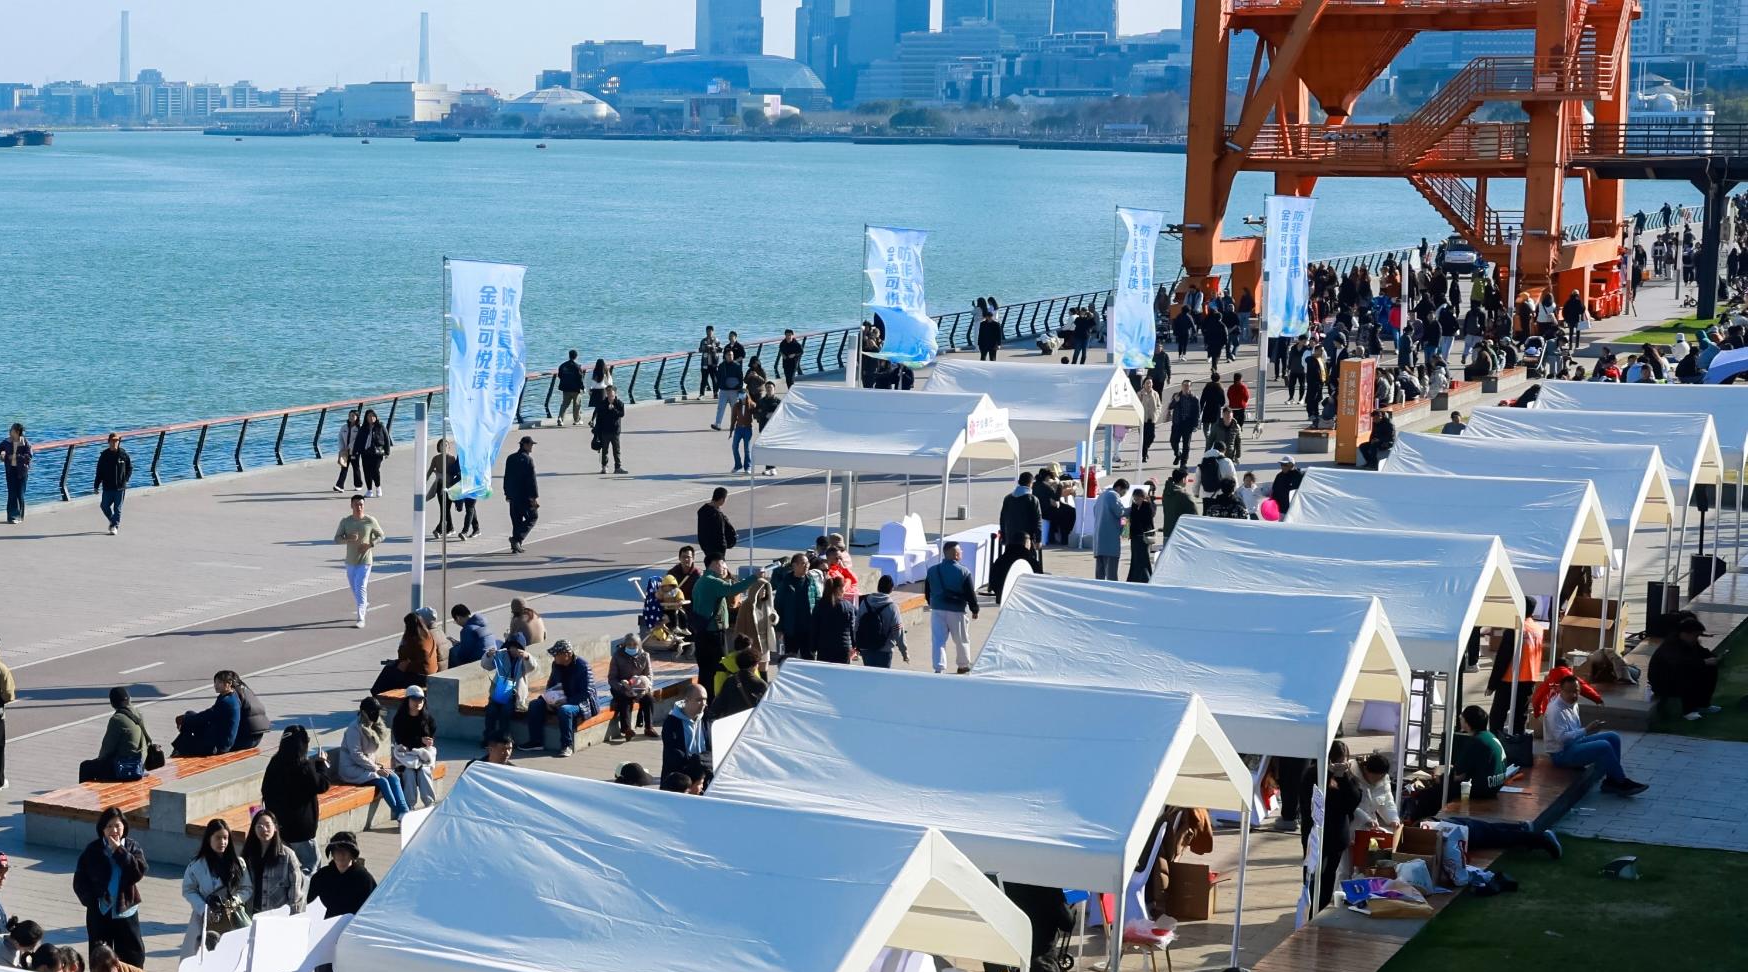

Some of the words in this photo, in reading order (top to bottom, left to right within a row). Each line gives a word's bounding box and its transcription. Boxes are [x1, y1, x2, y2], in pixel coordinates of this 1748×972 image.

[471, 285, 498, 391] 金融可悦读
